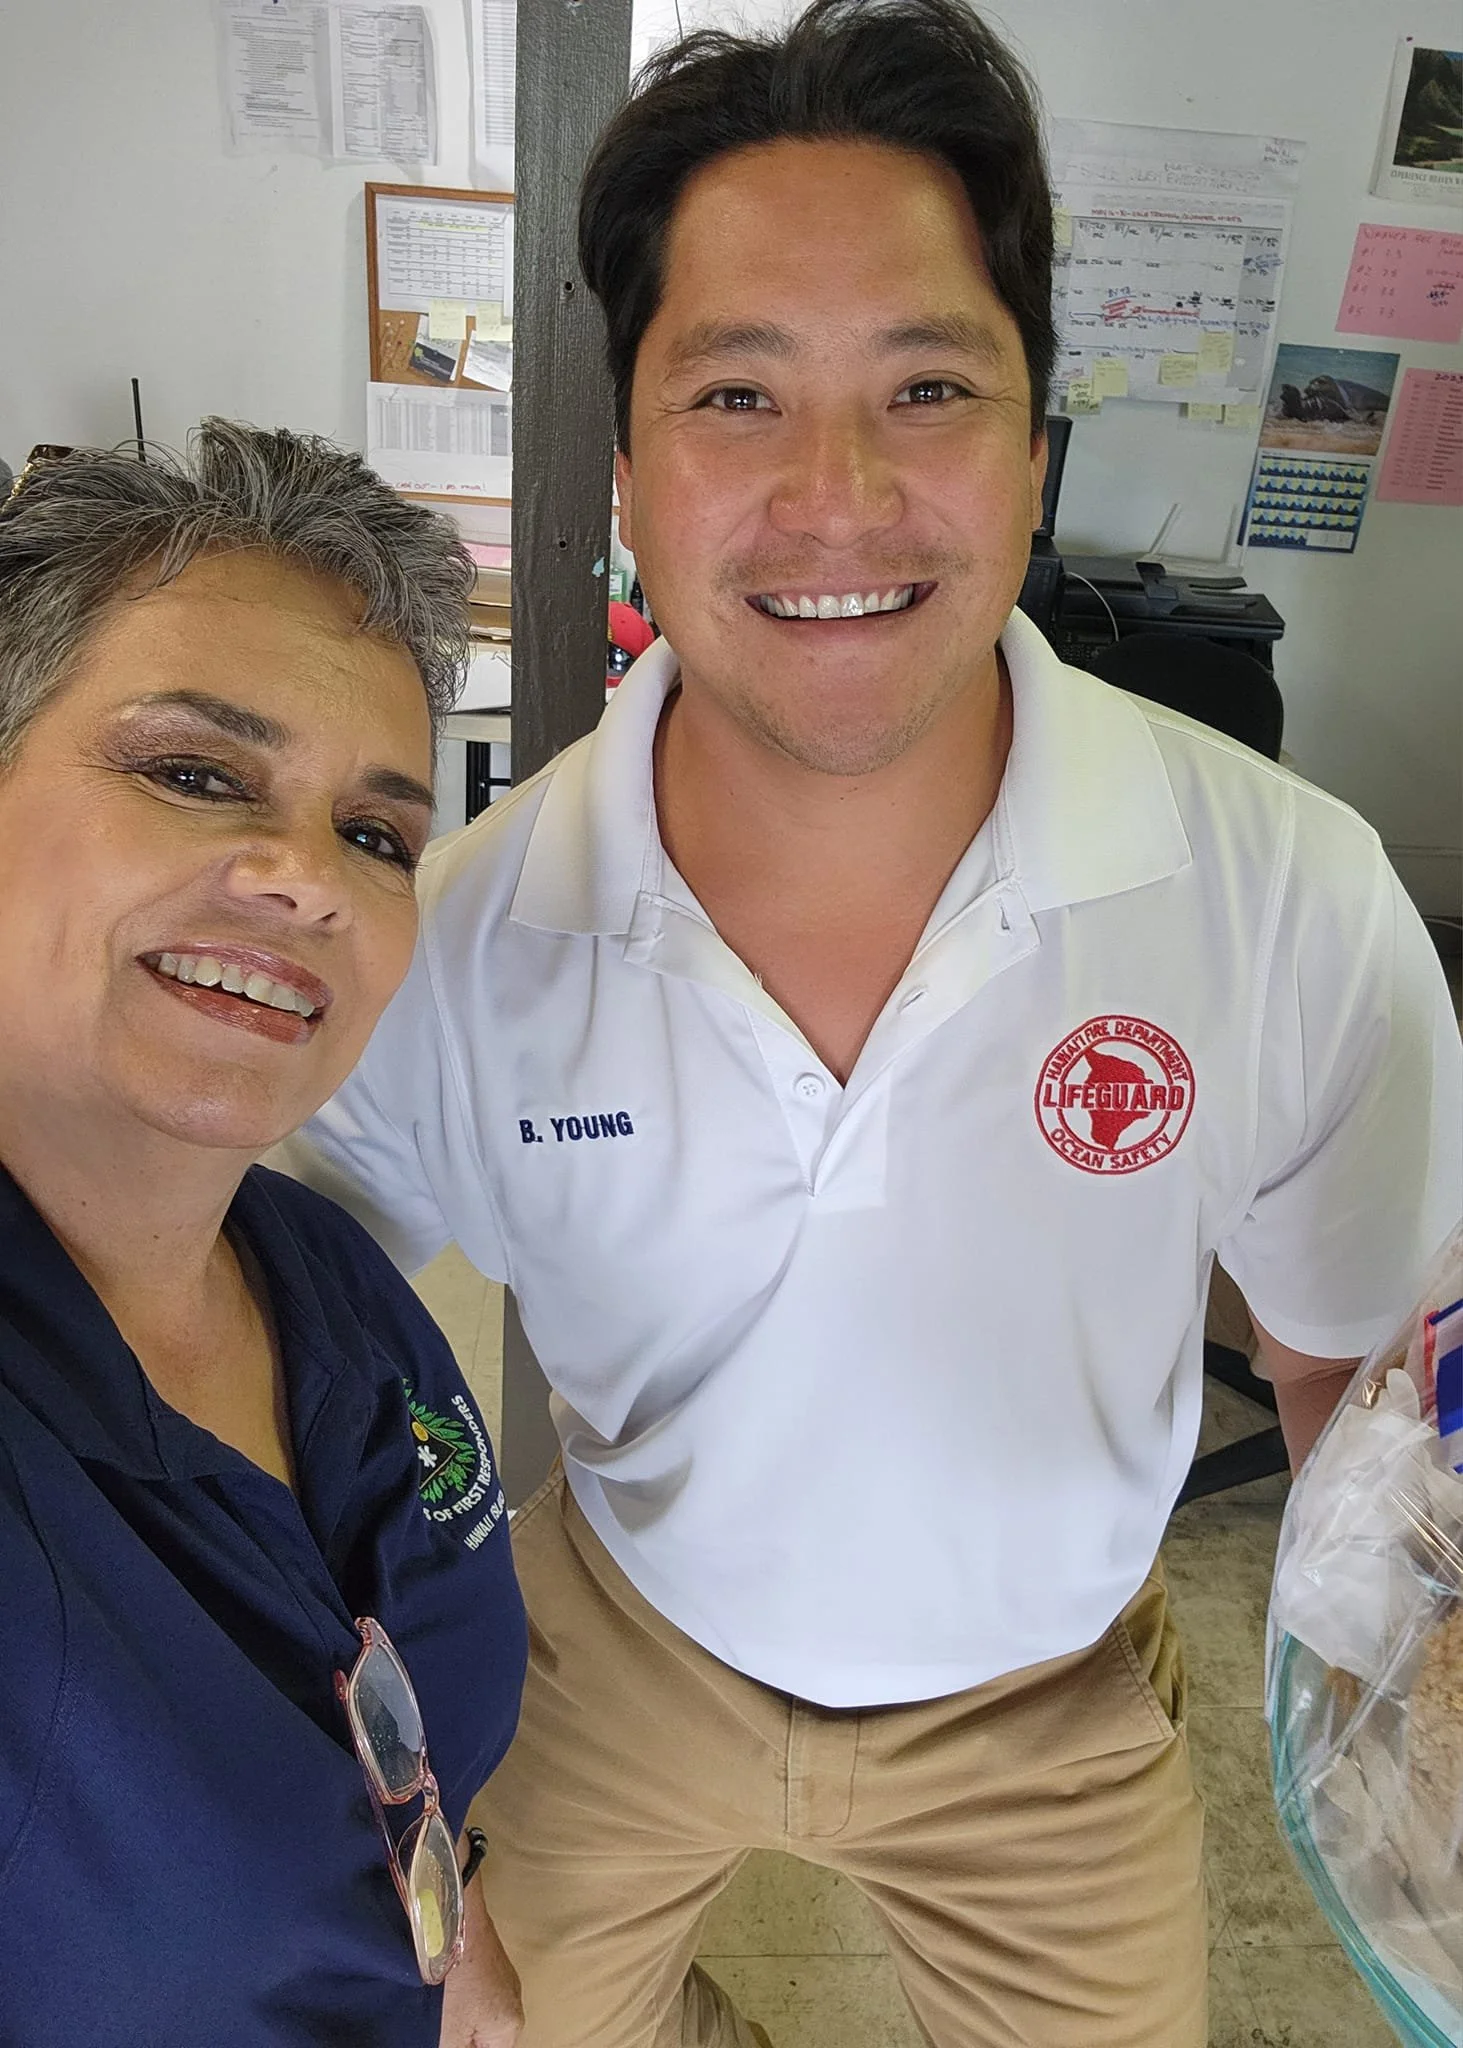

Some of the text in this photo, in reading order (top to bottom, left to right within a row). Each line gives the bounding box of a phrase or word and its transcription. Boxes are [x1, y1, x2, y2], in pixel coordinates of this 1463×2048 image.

[1084, 1021, 1111, 1043] FIRE
[1114, 1021, 1189, 1082] DEPARTMENT
[1042, 1083, 1185, 1111] LIFEGUARD
[518, 1111, 634, 1143] B. YOUNG
[1050, 1128, 1172, 1169] OCEAN SAFETY
[433, 1394, 491, 1522] OF FIRST RESPONDERS
